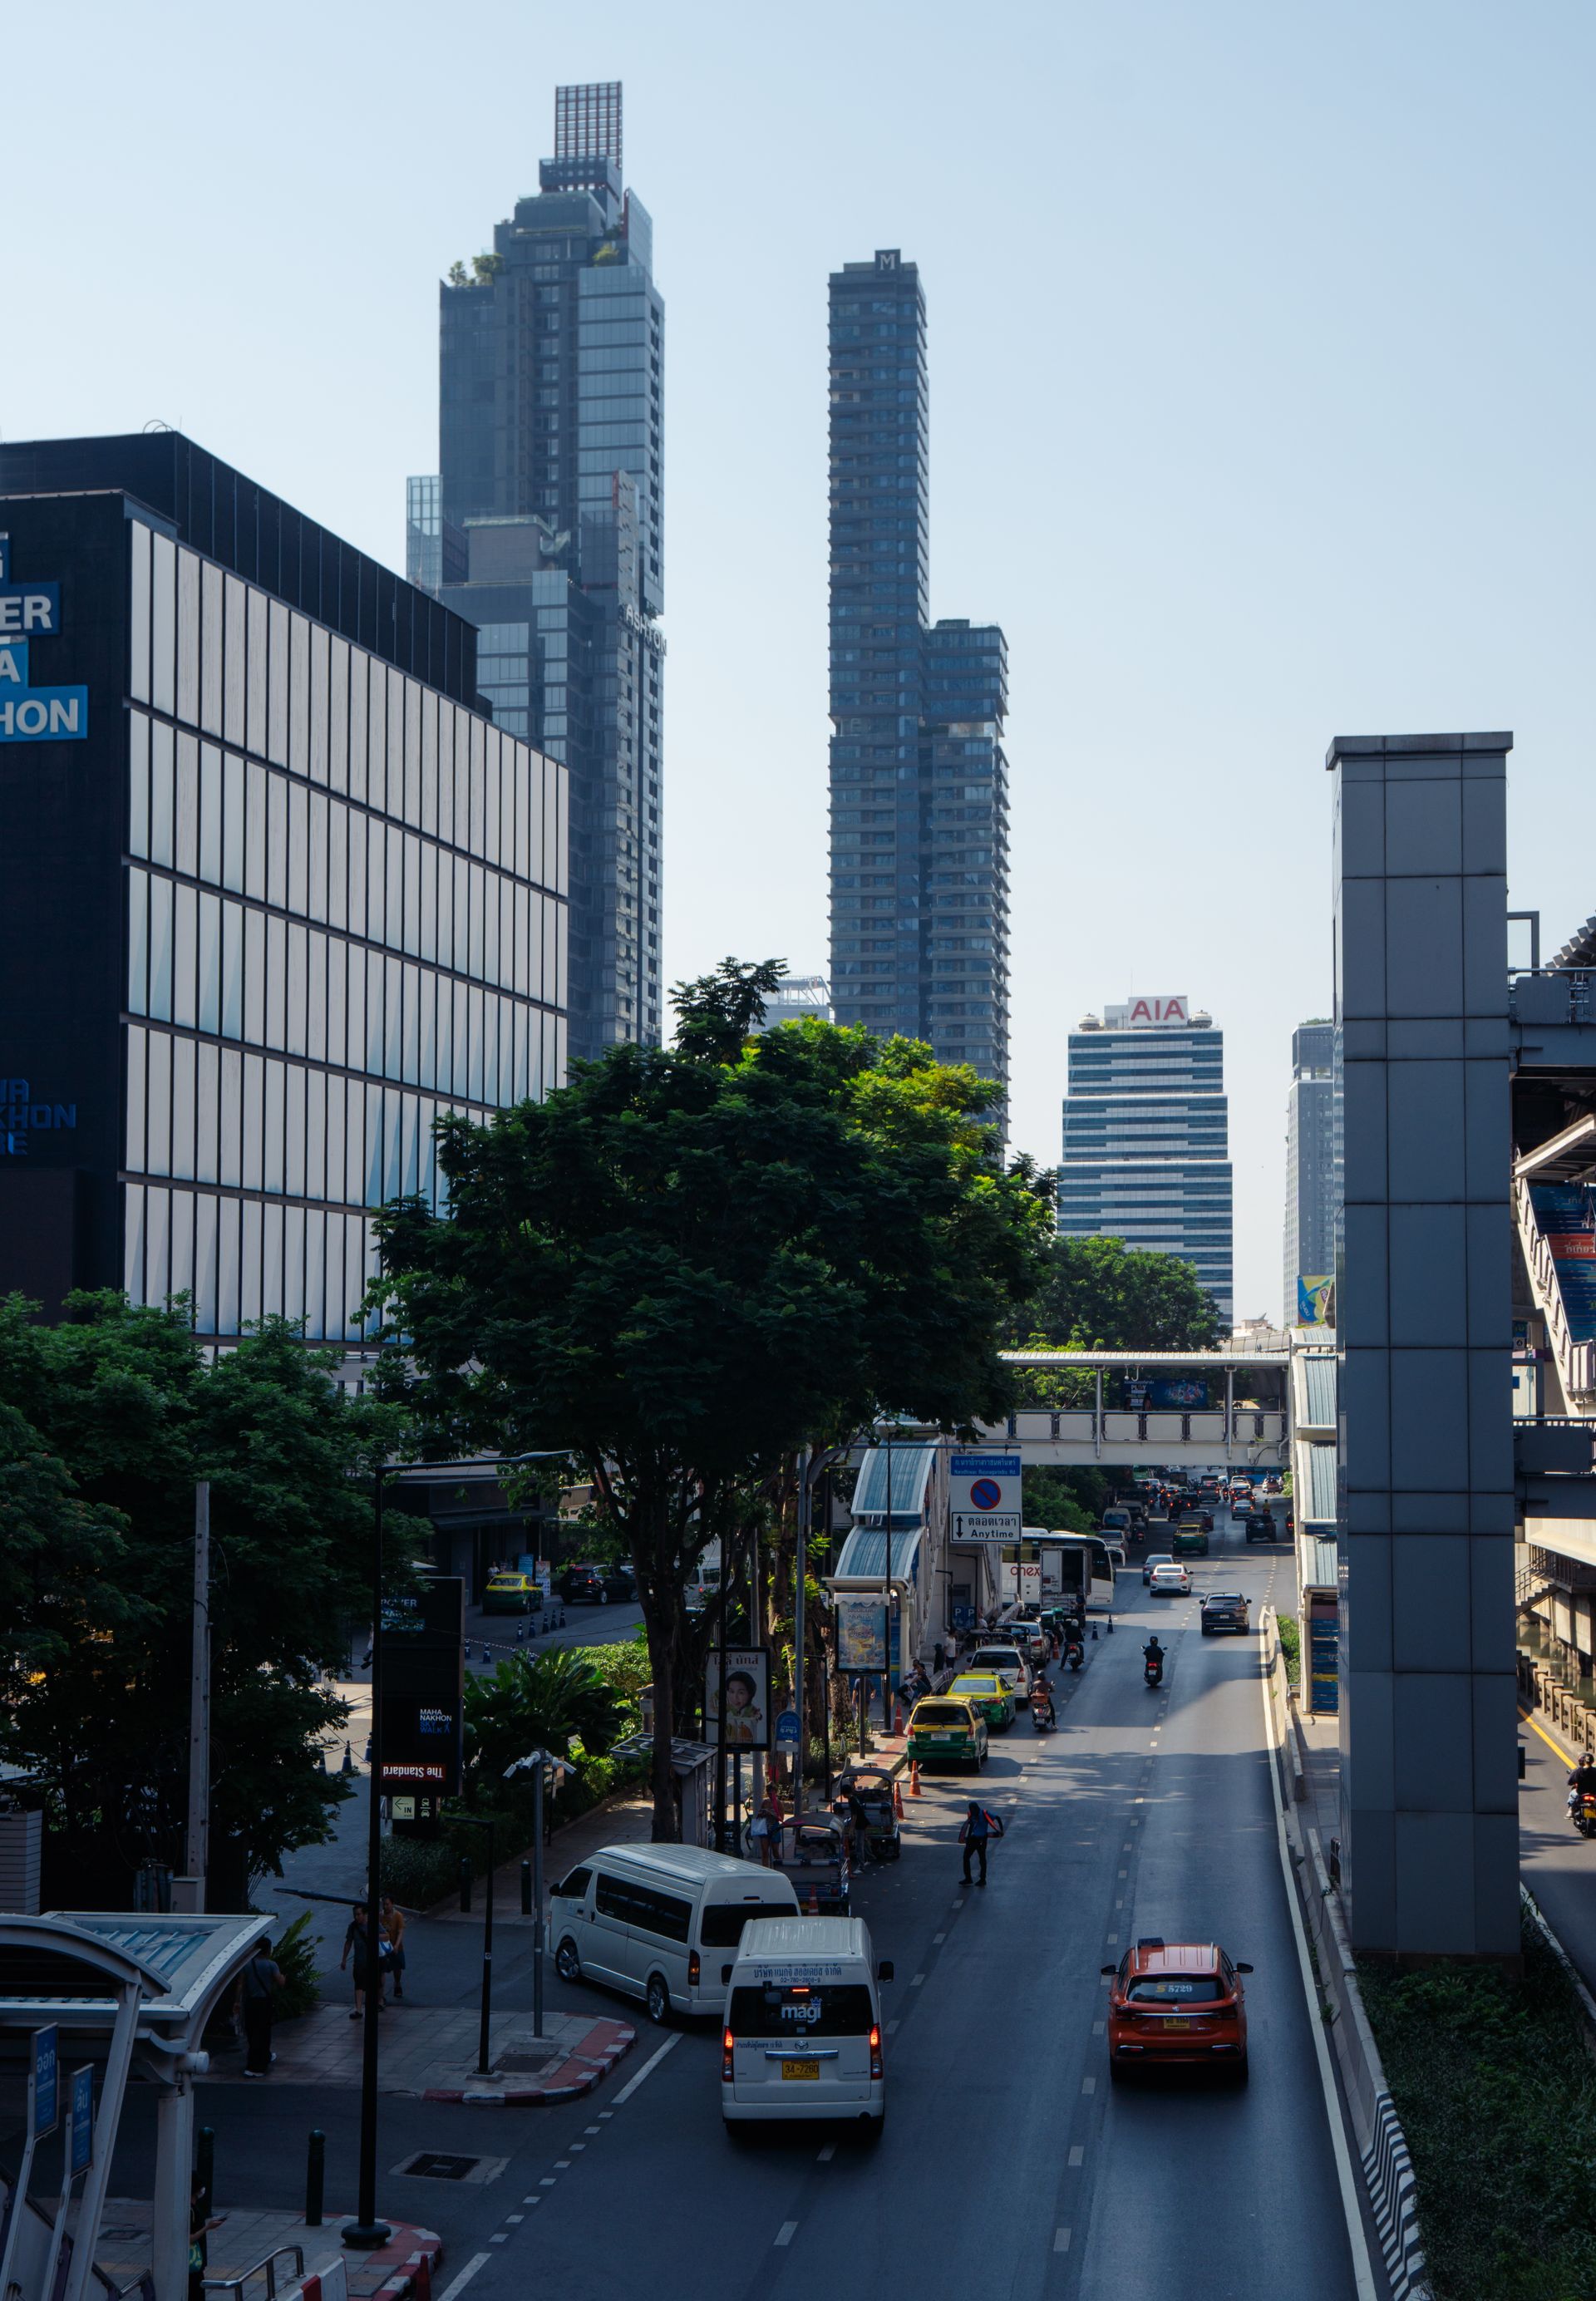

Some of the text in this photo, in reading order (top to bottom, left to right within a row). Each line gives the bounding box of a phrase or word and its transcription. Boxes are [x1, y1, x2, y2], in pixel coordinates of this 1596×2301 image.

[879, 254, 896, 270] M
[626, 604, 667, 656] ASHTON
[1130, 999, 1185, 1021] AIA
[968, 1517, 1017, 1526] ตลอดเวลา
[971, 1530, 1014, 1539] Anytime
[955, 1608, 962, 1616] P
[968, 1609, 974, 1617] P
[383, 1766, 443, 1778] The Standard
[781, 2005, 821, 2023] magi
